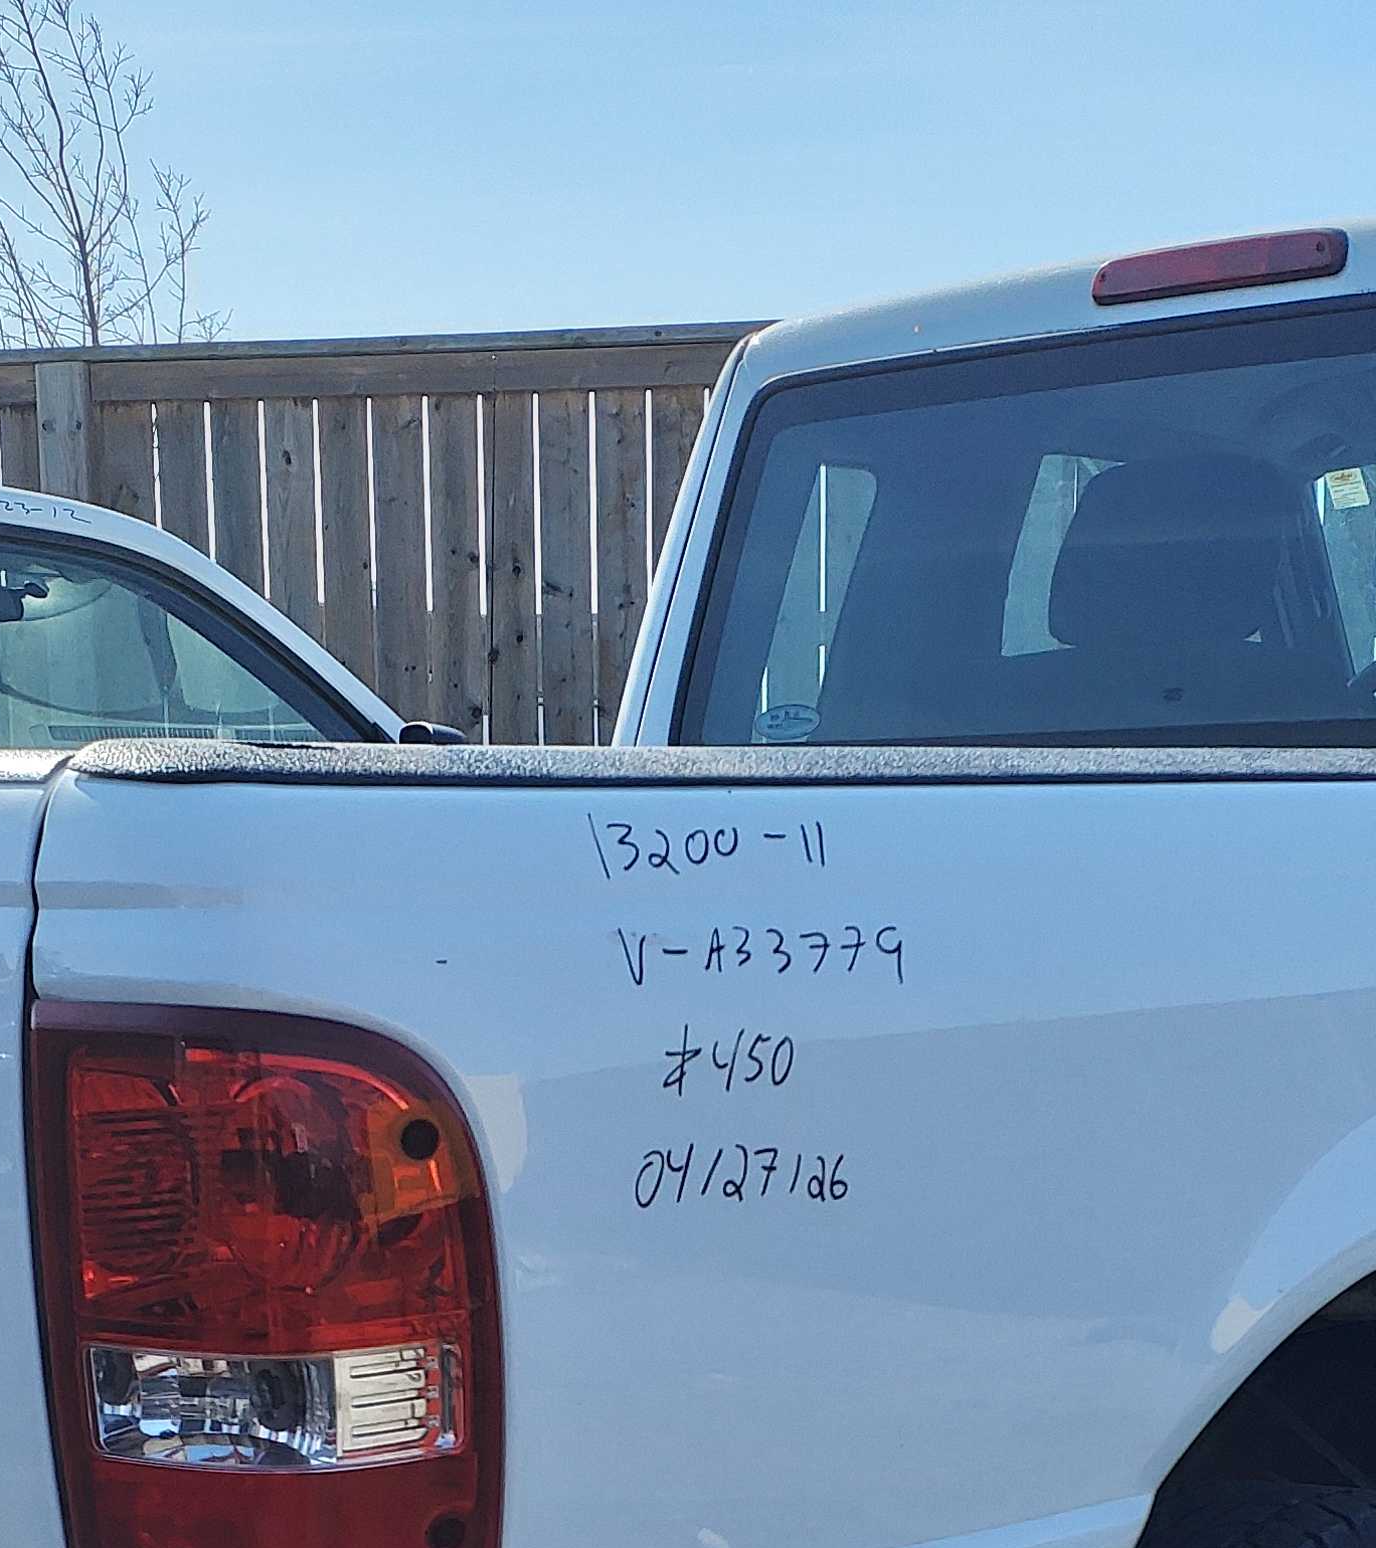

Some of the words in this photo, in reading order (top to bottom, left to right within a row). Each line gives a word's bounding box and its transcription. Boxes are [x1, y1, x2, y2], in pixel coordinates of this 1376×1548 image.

[587, 813, 826, 879] 13200-11
[617, 926, 904, 985] V-A33779
[635, 1143, 849, 1208] 04/27/26
